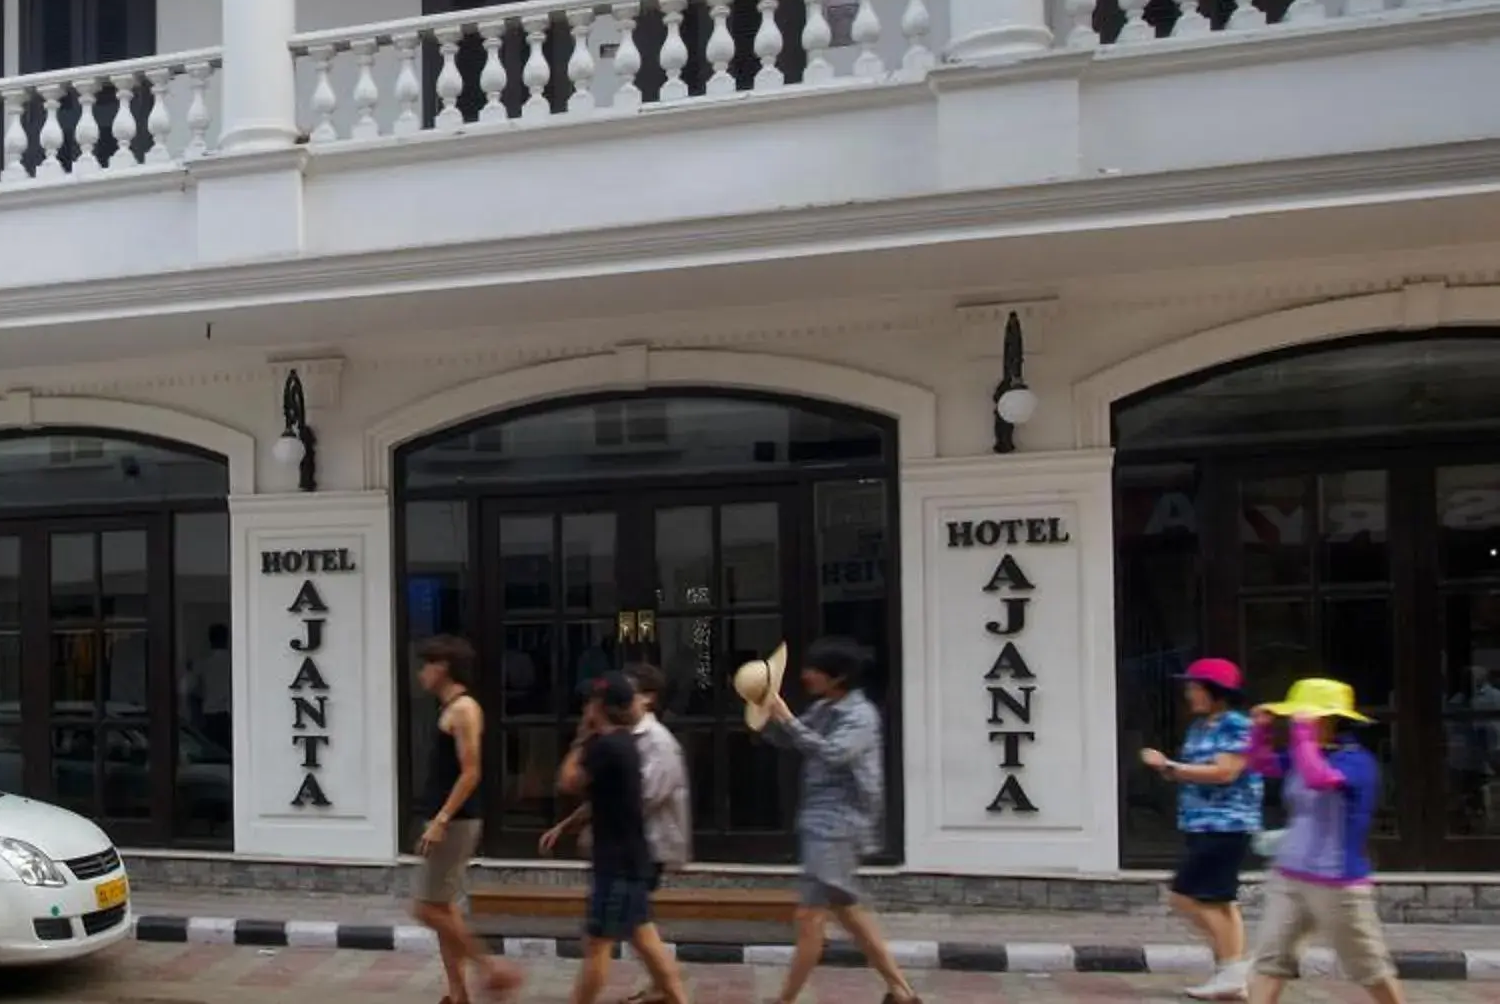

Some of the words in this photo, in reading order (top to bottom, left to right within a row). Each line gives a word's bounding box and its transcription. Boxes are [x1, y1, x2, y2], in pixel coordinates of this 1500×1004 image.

[261, 549, 356, 573] HOTEL
[946, 518, 1070, 546] HOTEL
[287, 579, 332, 807] AJANTA
[982, 553, 1039, 813] AJANTA
